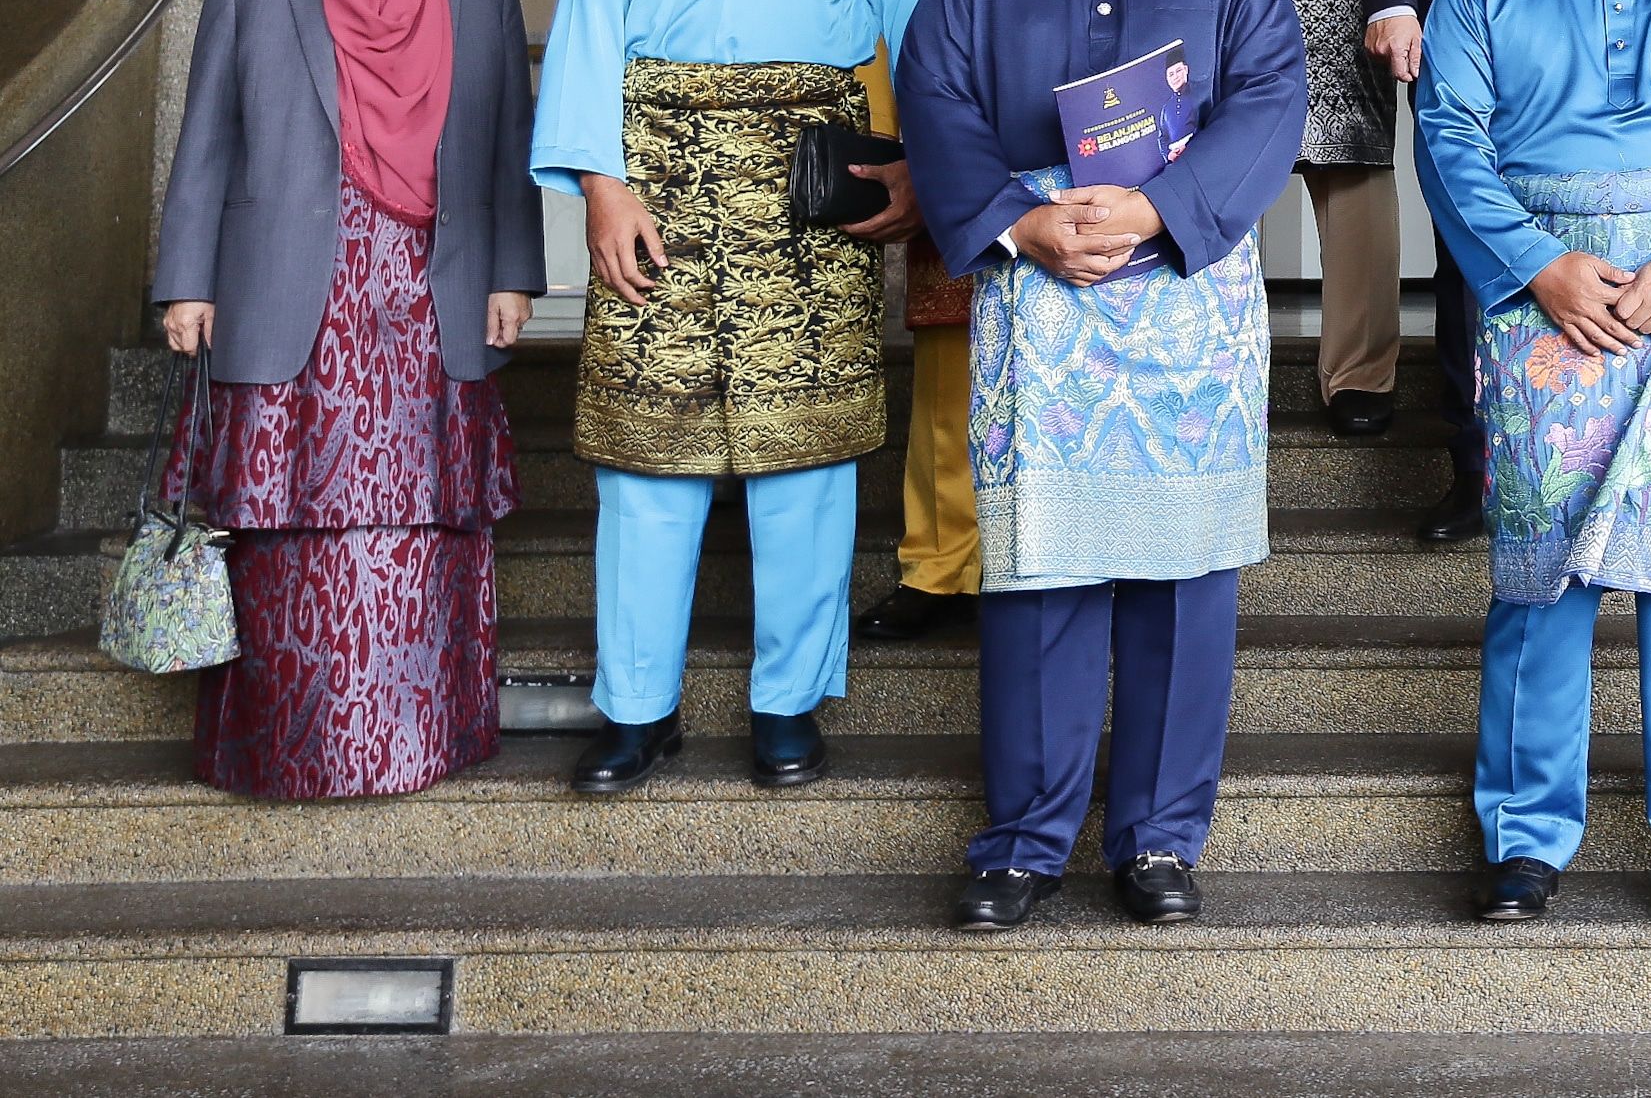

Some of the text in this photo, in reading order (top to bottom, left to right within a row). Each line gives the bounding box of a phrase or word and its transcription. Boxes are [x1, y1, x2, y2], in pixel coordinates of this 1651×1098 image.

[1097, 115, 1155, 144] BELANJAWAN
[1098, 124, 1157, 152] SELANGOR 2021
